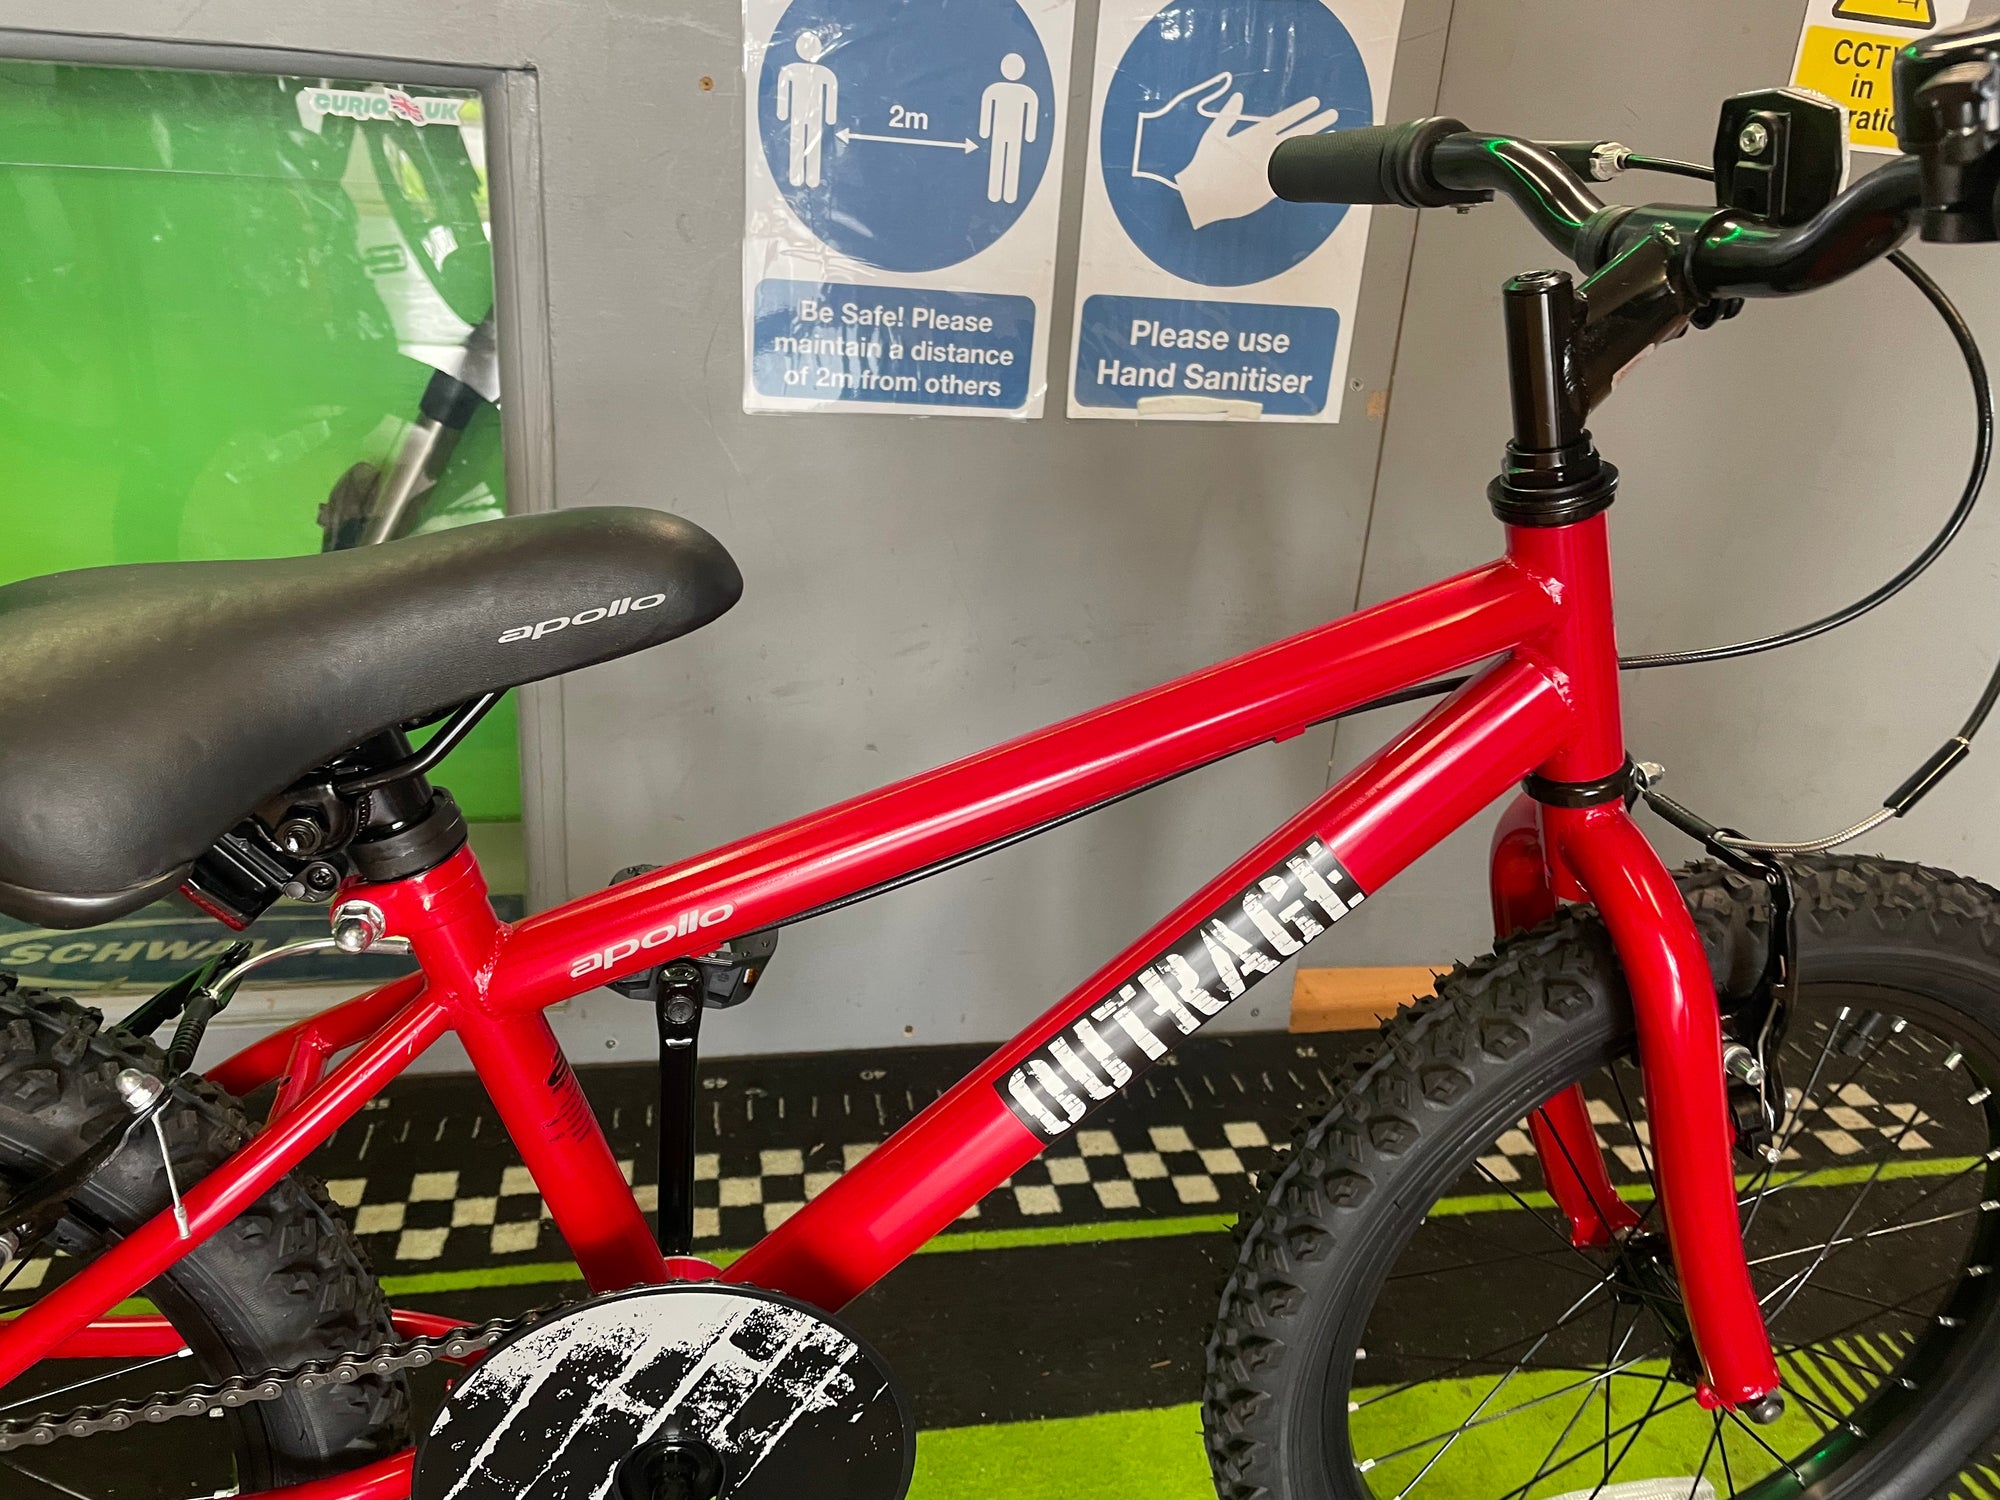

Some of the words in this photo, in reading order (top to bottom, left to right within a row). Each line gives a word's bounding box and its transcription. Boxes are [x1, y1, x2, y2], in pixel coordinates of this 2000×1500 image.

[1834, 39, 1899, 69] CCT
[1850, 73, 1873, 99] in
[314, 92, 389, 117] CURIO
[425, 102, 459, 120] UK
[888, 104, 928, 130] 2m
[800, 299, 834, 323] Be
[841, 302, 904, 327] Safe!
[912, 307, 993, 333] Please
[774, 335, 882, 358] maintain
[889, 344, 904, 360] a
[911, 341, 1014, 366] distance
[1130, 319, 1229, 351] Please
[1238, 331, 1290, 354] use
[784, 366, 808, 386] of
[816, 367, 852, 388] 2m
[861, 370, 917, 393] from
[925, 375, 1001, 397] others
[1097, 358, 1176, 388] Hand
[1184, 363, 1313, 394] Sanitiser
[498, 593, 666, 644] apollo
[569, 902, 734, 979] apollo
[1008, 841, 1365, 1135] OUTRAGE
